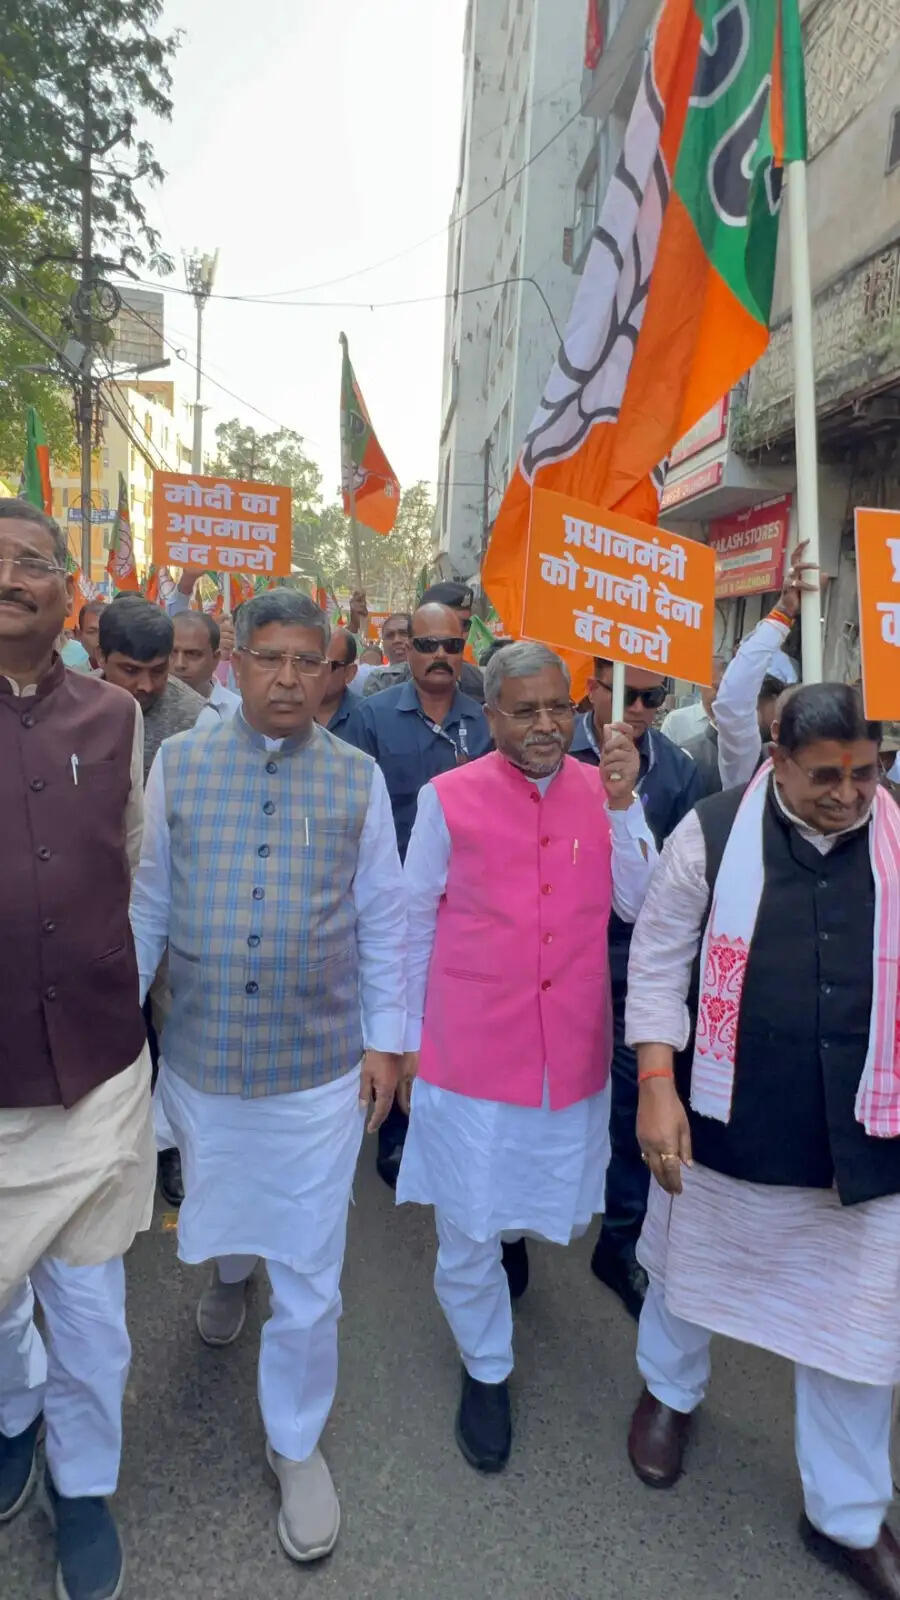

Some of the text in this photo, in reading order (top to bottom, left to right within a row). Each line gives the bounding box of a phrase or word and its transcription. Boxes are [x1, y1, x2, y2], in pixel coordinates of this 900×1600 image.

[162, 480, 280, 517] मोदी का
[166, 512, 280, 544] अपमान
[744, 520, 780, 546] STORES
[166, 537, 277, 571] बंद करो
[562, 514, 688, 581] प्रधानमंत्री
[539, 551, 580, 590] को
[583, 566, 651, 612] गाली
[653, 581, 703, 629] देना
[572, 605, 671, 664] बंद करो
